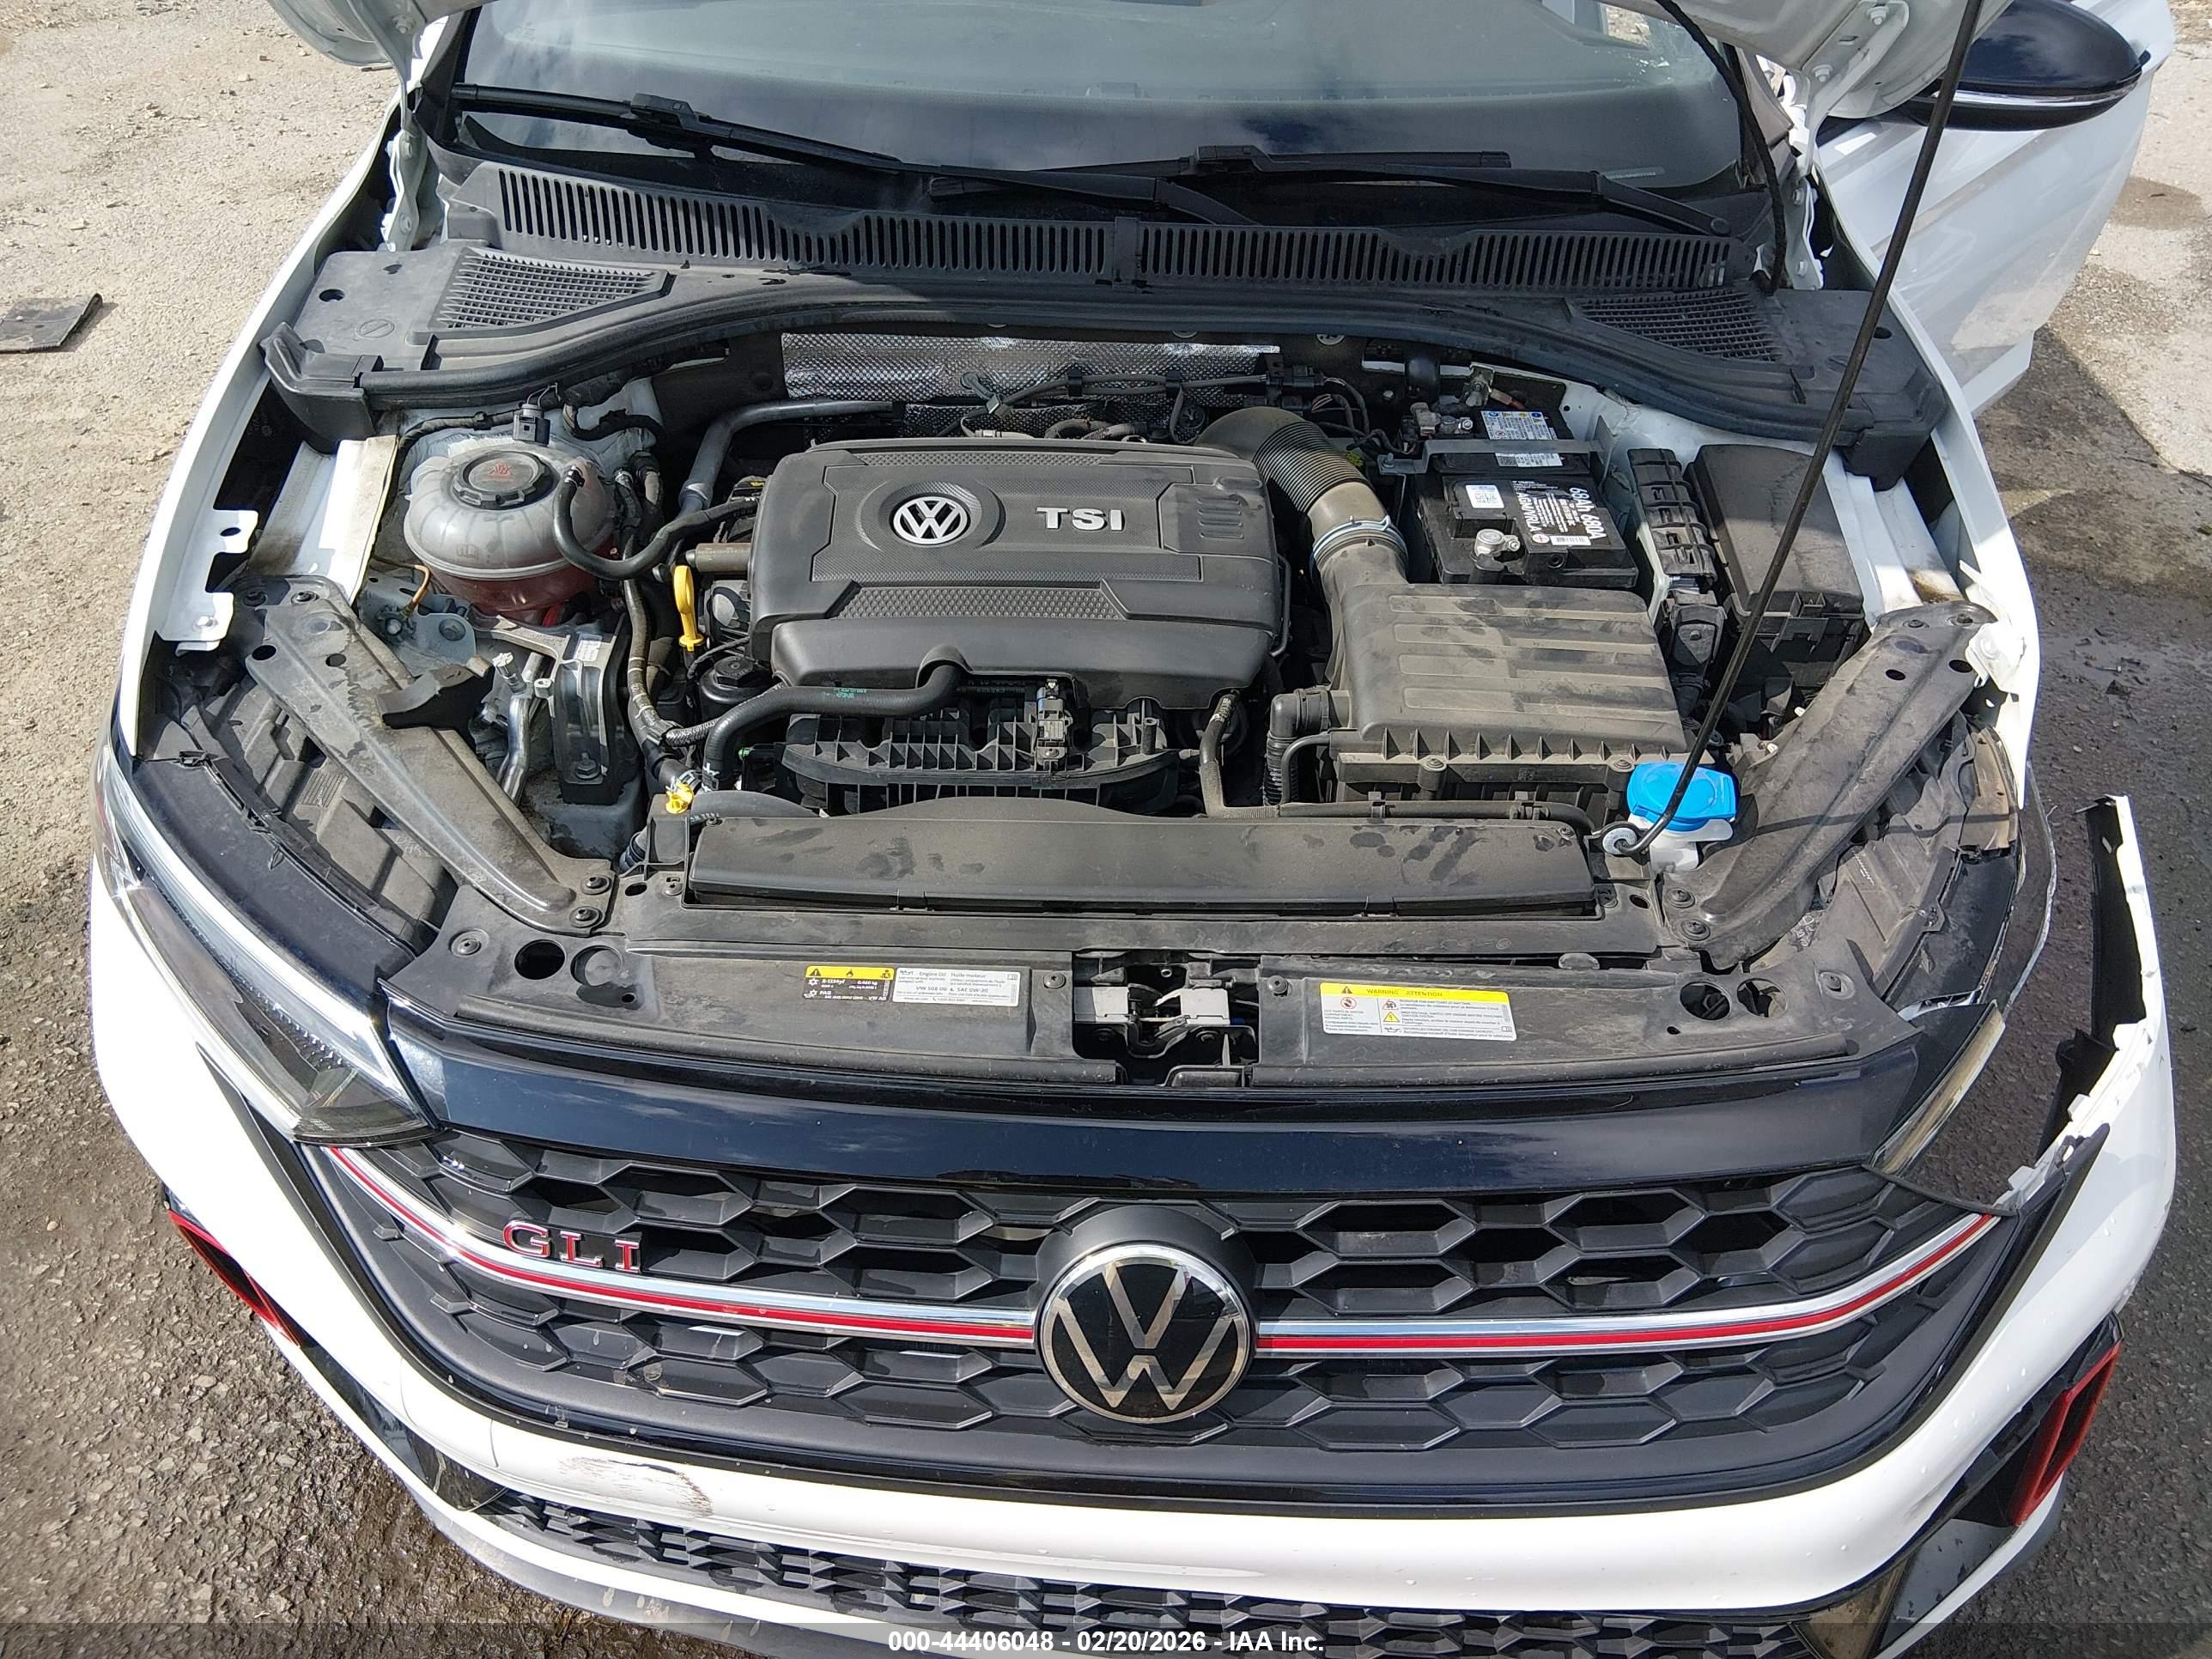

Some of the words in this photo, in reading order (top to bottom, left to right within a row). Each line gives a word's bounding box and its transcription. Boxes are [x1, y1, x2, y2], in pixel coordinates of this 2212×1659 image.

[1569, 487, 1594, 512] 68Ah
[893, 495, 968, 545] VW
[1036, 507, 1124, 531] TSI
[1580, 514, 1607, 539] 680A
[503, 1220, 641, 1273] GLI
